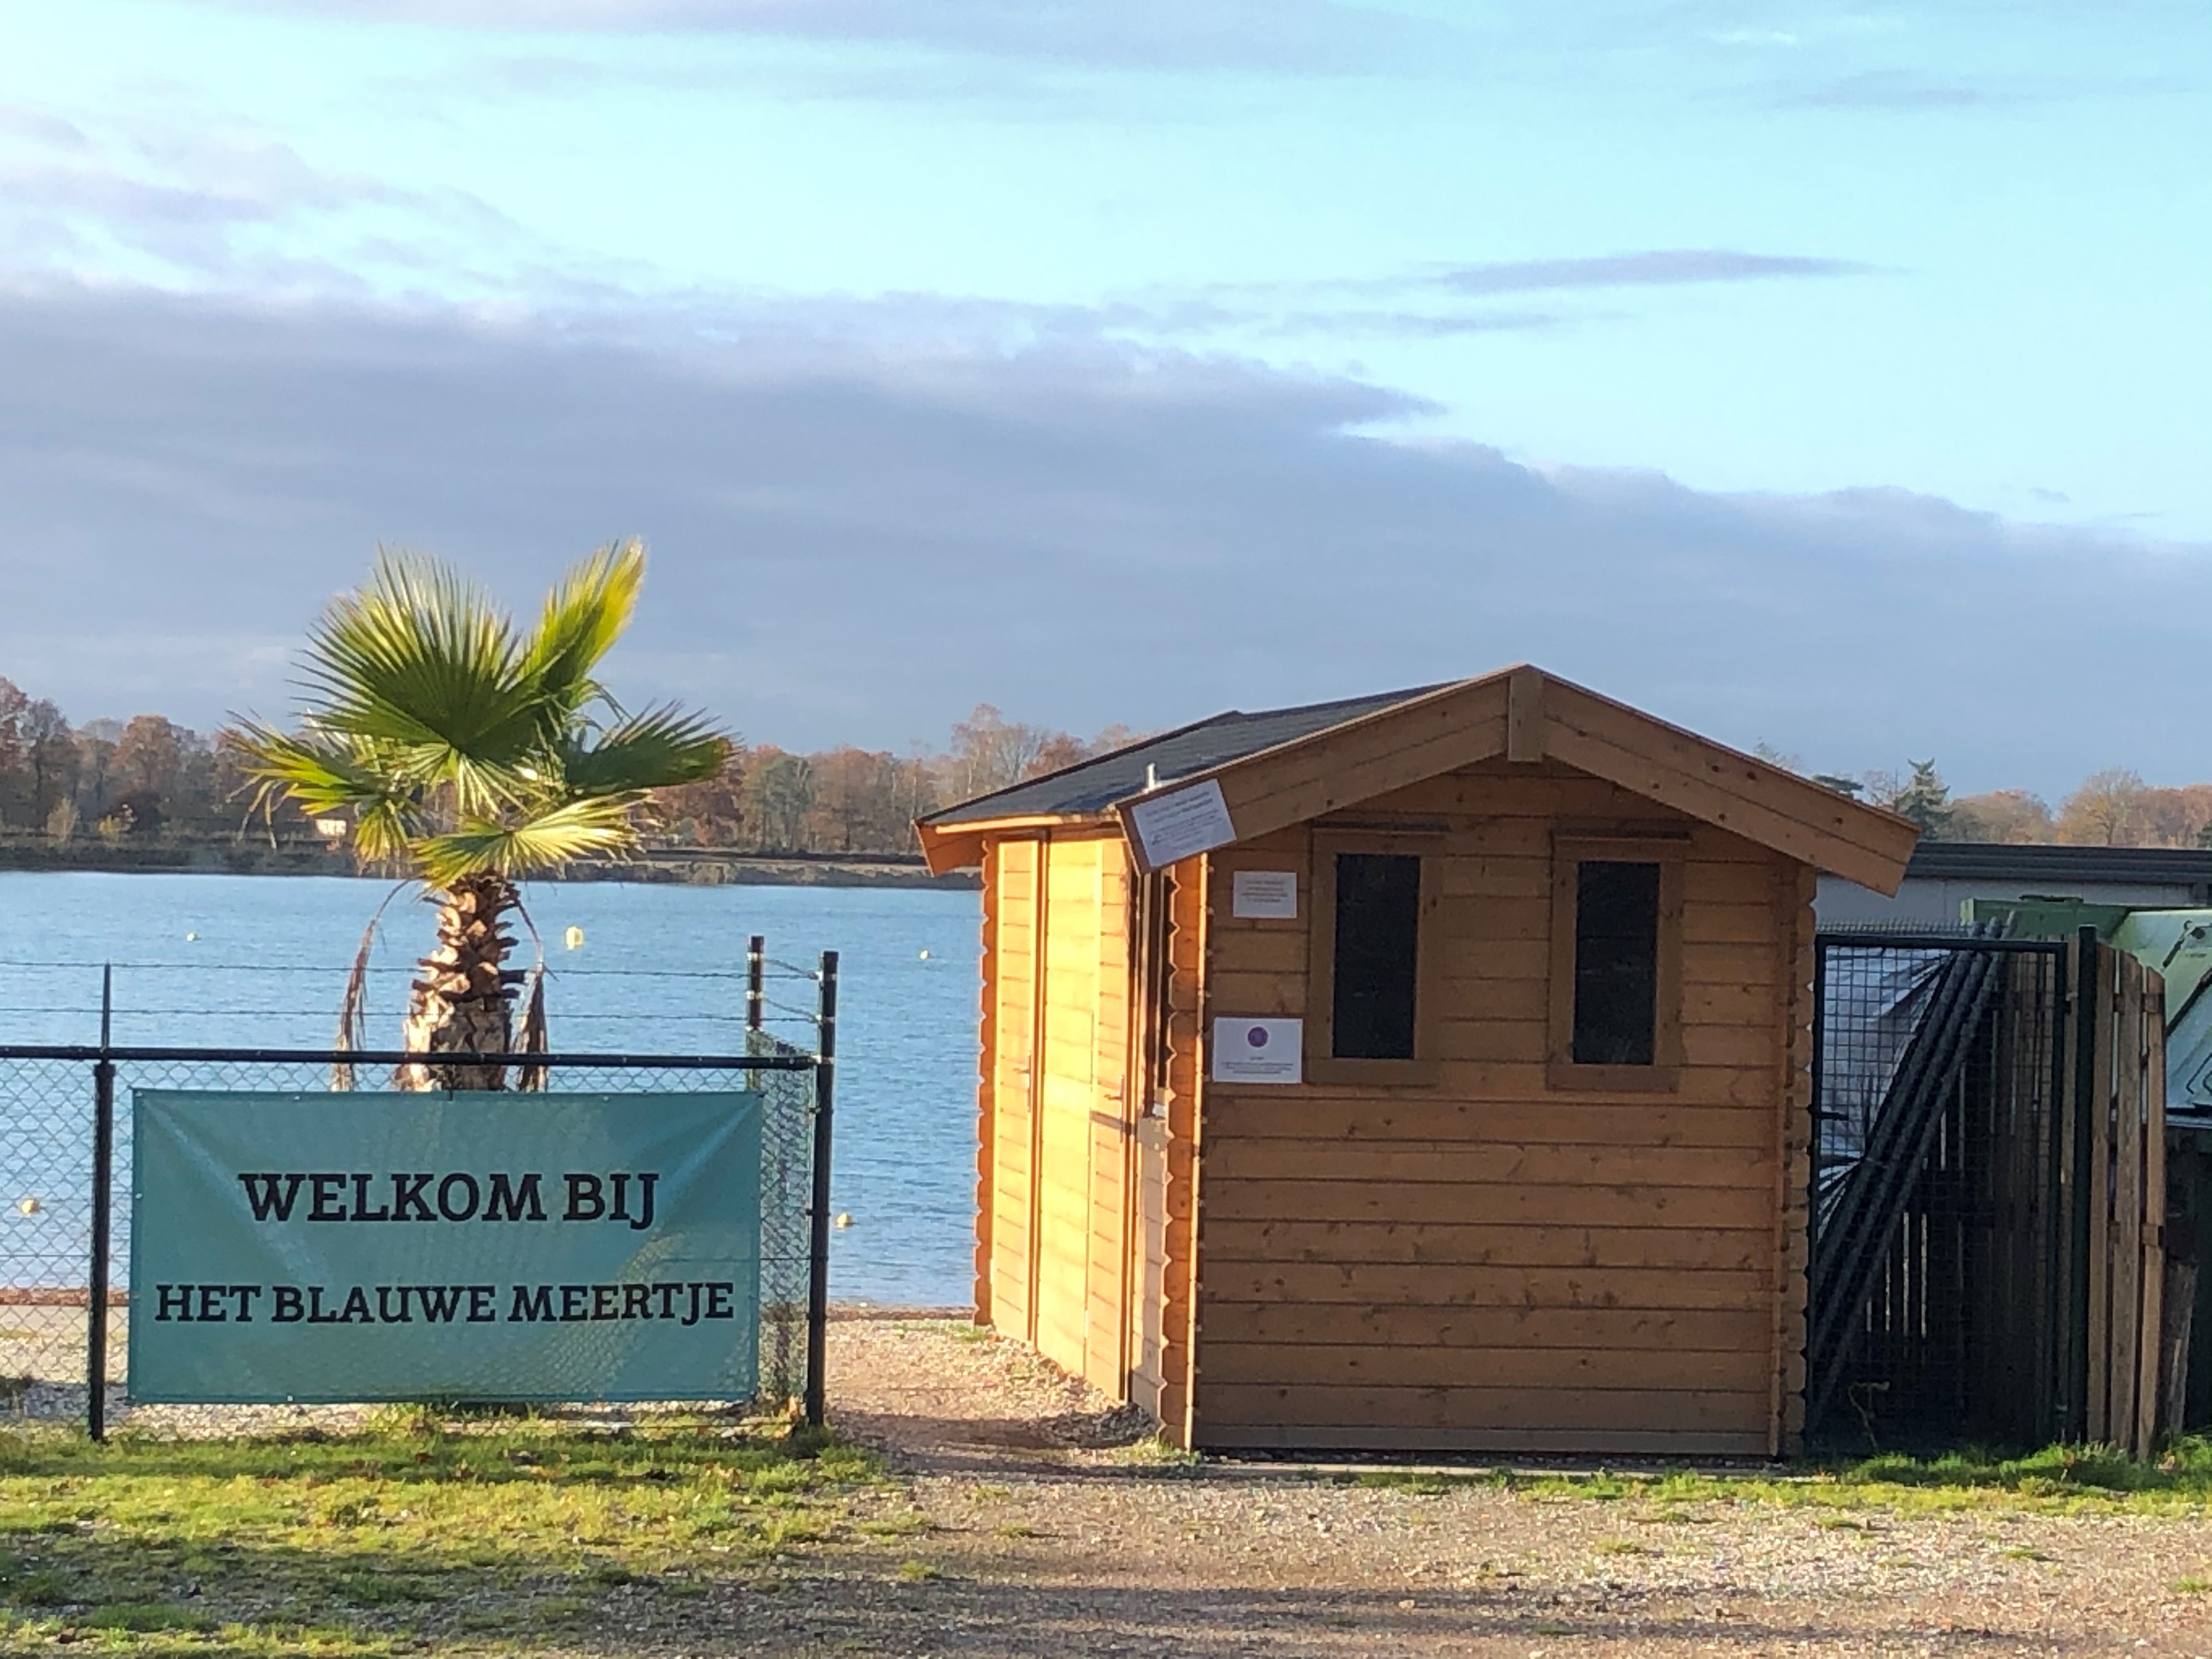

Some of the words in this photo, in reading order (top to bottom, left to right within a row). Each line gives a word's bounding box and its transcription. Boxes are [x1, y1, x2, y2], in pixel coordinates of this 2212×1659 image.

[238, 1172, 547, 1223] WELKOM
[563, 1173, 659, 1230] BIJ
[154, 1284, 262, 1323] HET
[271, 1284, 497, 1324] BLAUWE
[507, 1281, 735, 1326] MEERTJE
